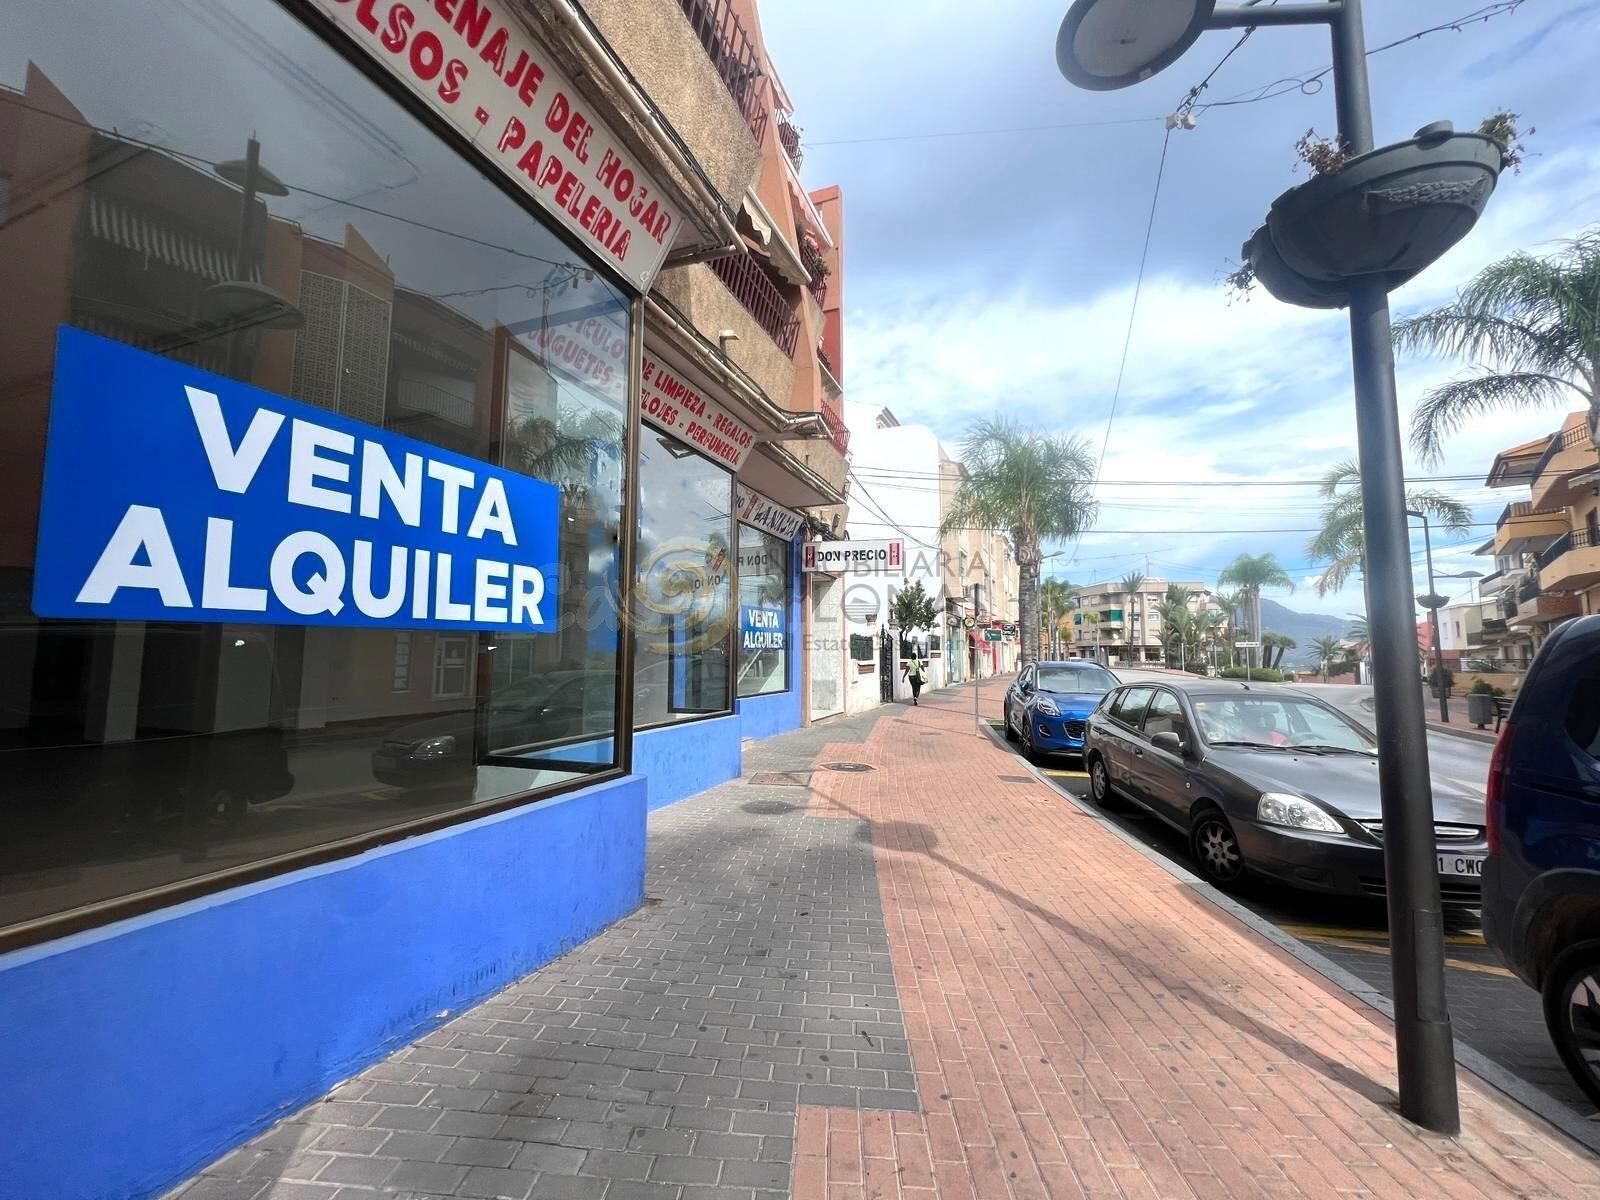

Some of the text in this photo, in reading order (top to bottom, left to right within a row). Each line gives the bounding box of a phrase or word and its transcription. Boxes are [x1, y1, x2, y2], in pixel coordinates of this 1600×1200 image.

[334, 0, 469, 104] LSOS
[497, 116, 632, 262] PAPELERIA
[426, 0, 671, 245] ENAJE DEL HOGAR
[654, 370, 706, 418] LIMPIEZA
[713, 413, 753, 449] REGALOS
[685, 421, 741, 465] PERFUMERIA
[184, 385, 518, 546] VENTA
[75, 503, 545, 625] ALQUILER
[817, 549, 887, 562] DON PRECIO
[743, 630, 783, 649] ALQUILER
[748, 608, 779, 628] VENTA
